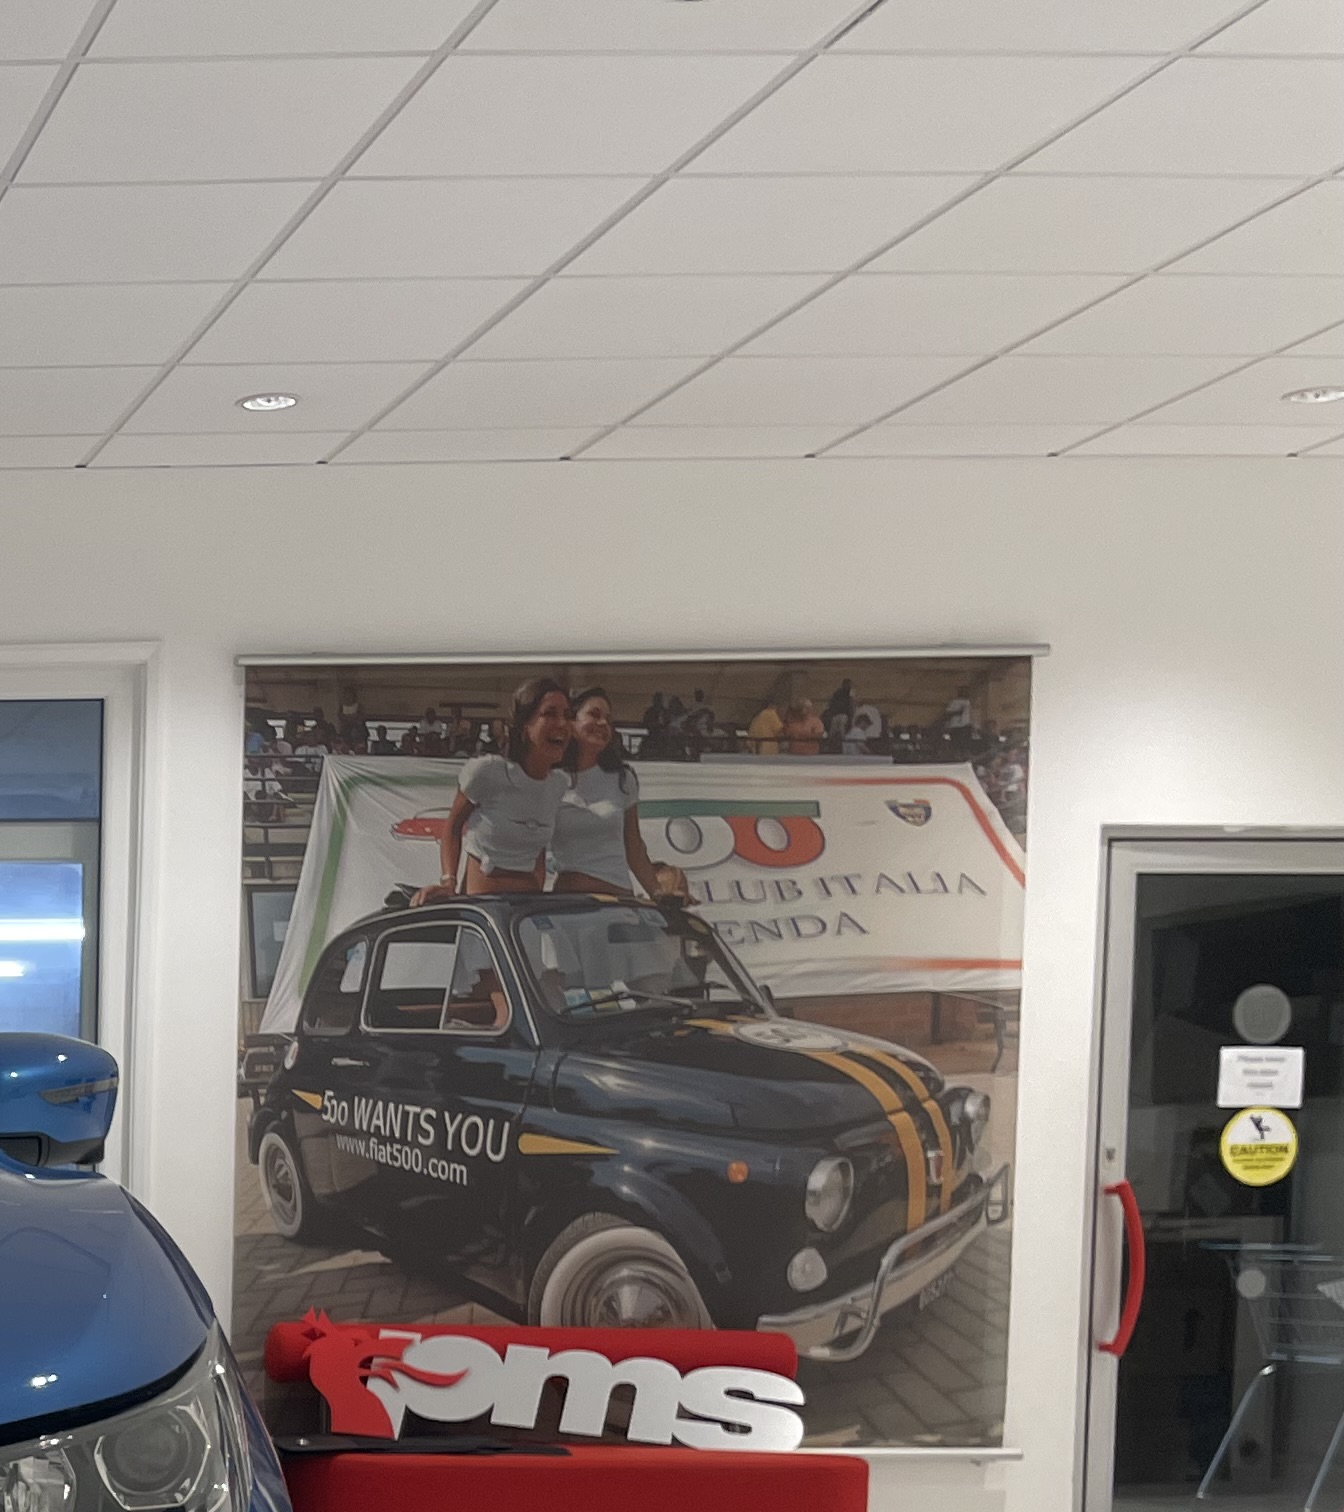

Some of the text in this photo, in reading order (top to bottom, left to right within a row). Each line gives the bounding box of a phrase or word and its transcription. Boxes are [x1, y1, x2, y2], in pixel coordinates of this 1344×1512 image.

[818, 872, 987, 898] ITALIA
[713, 911, 870, 945] ENDA
[353, 1095, 437, 1146] WANTS
[443, 1110, 511, 1163] YOU
[335, 1132, 468, 1187] www.fiat500.com
